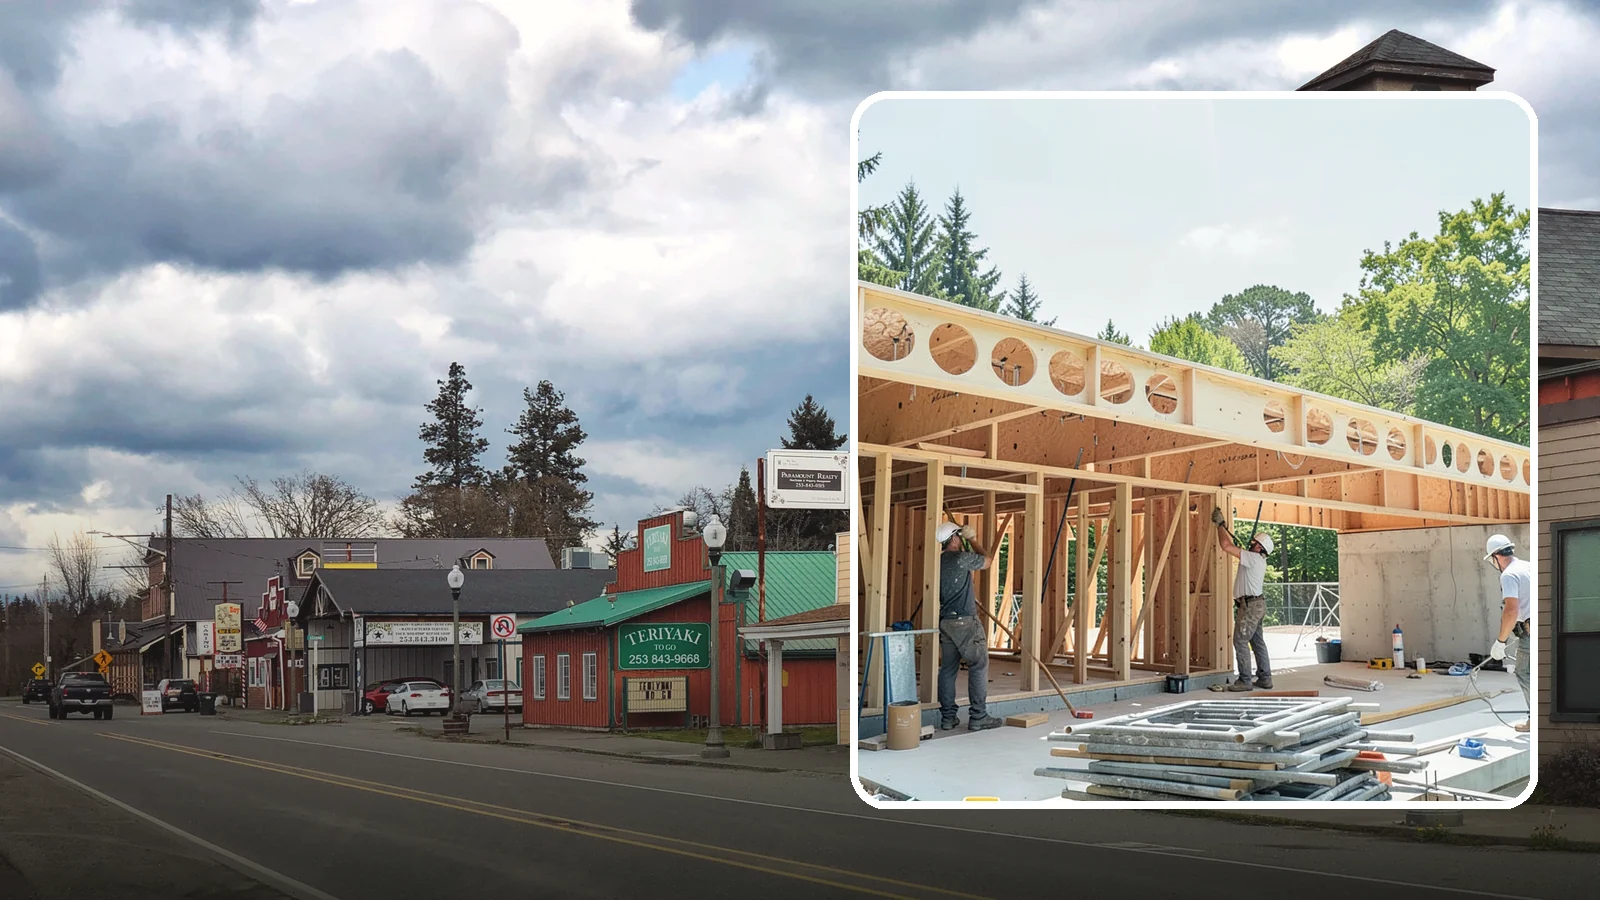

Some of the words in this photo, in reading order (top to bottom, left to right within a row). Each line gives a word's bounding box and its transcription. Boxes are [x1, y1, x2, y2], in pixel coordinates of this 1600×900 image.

[625, 628, 702, 645] TERIYAKI
[629, 655, 648, 664] 253
[652, 654, 699, 664] 843-9668
